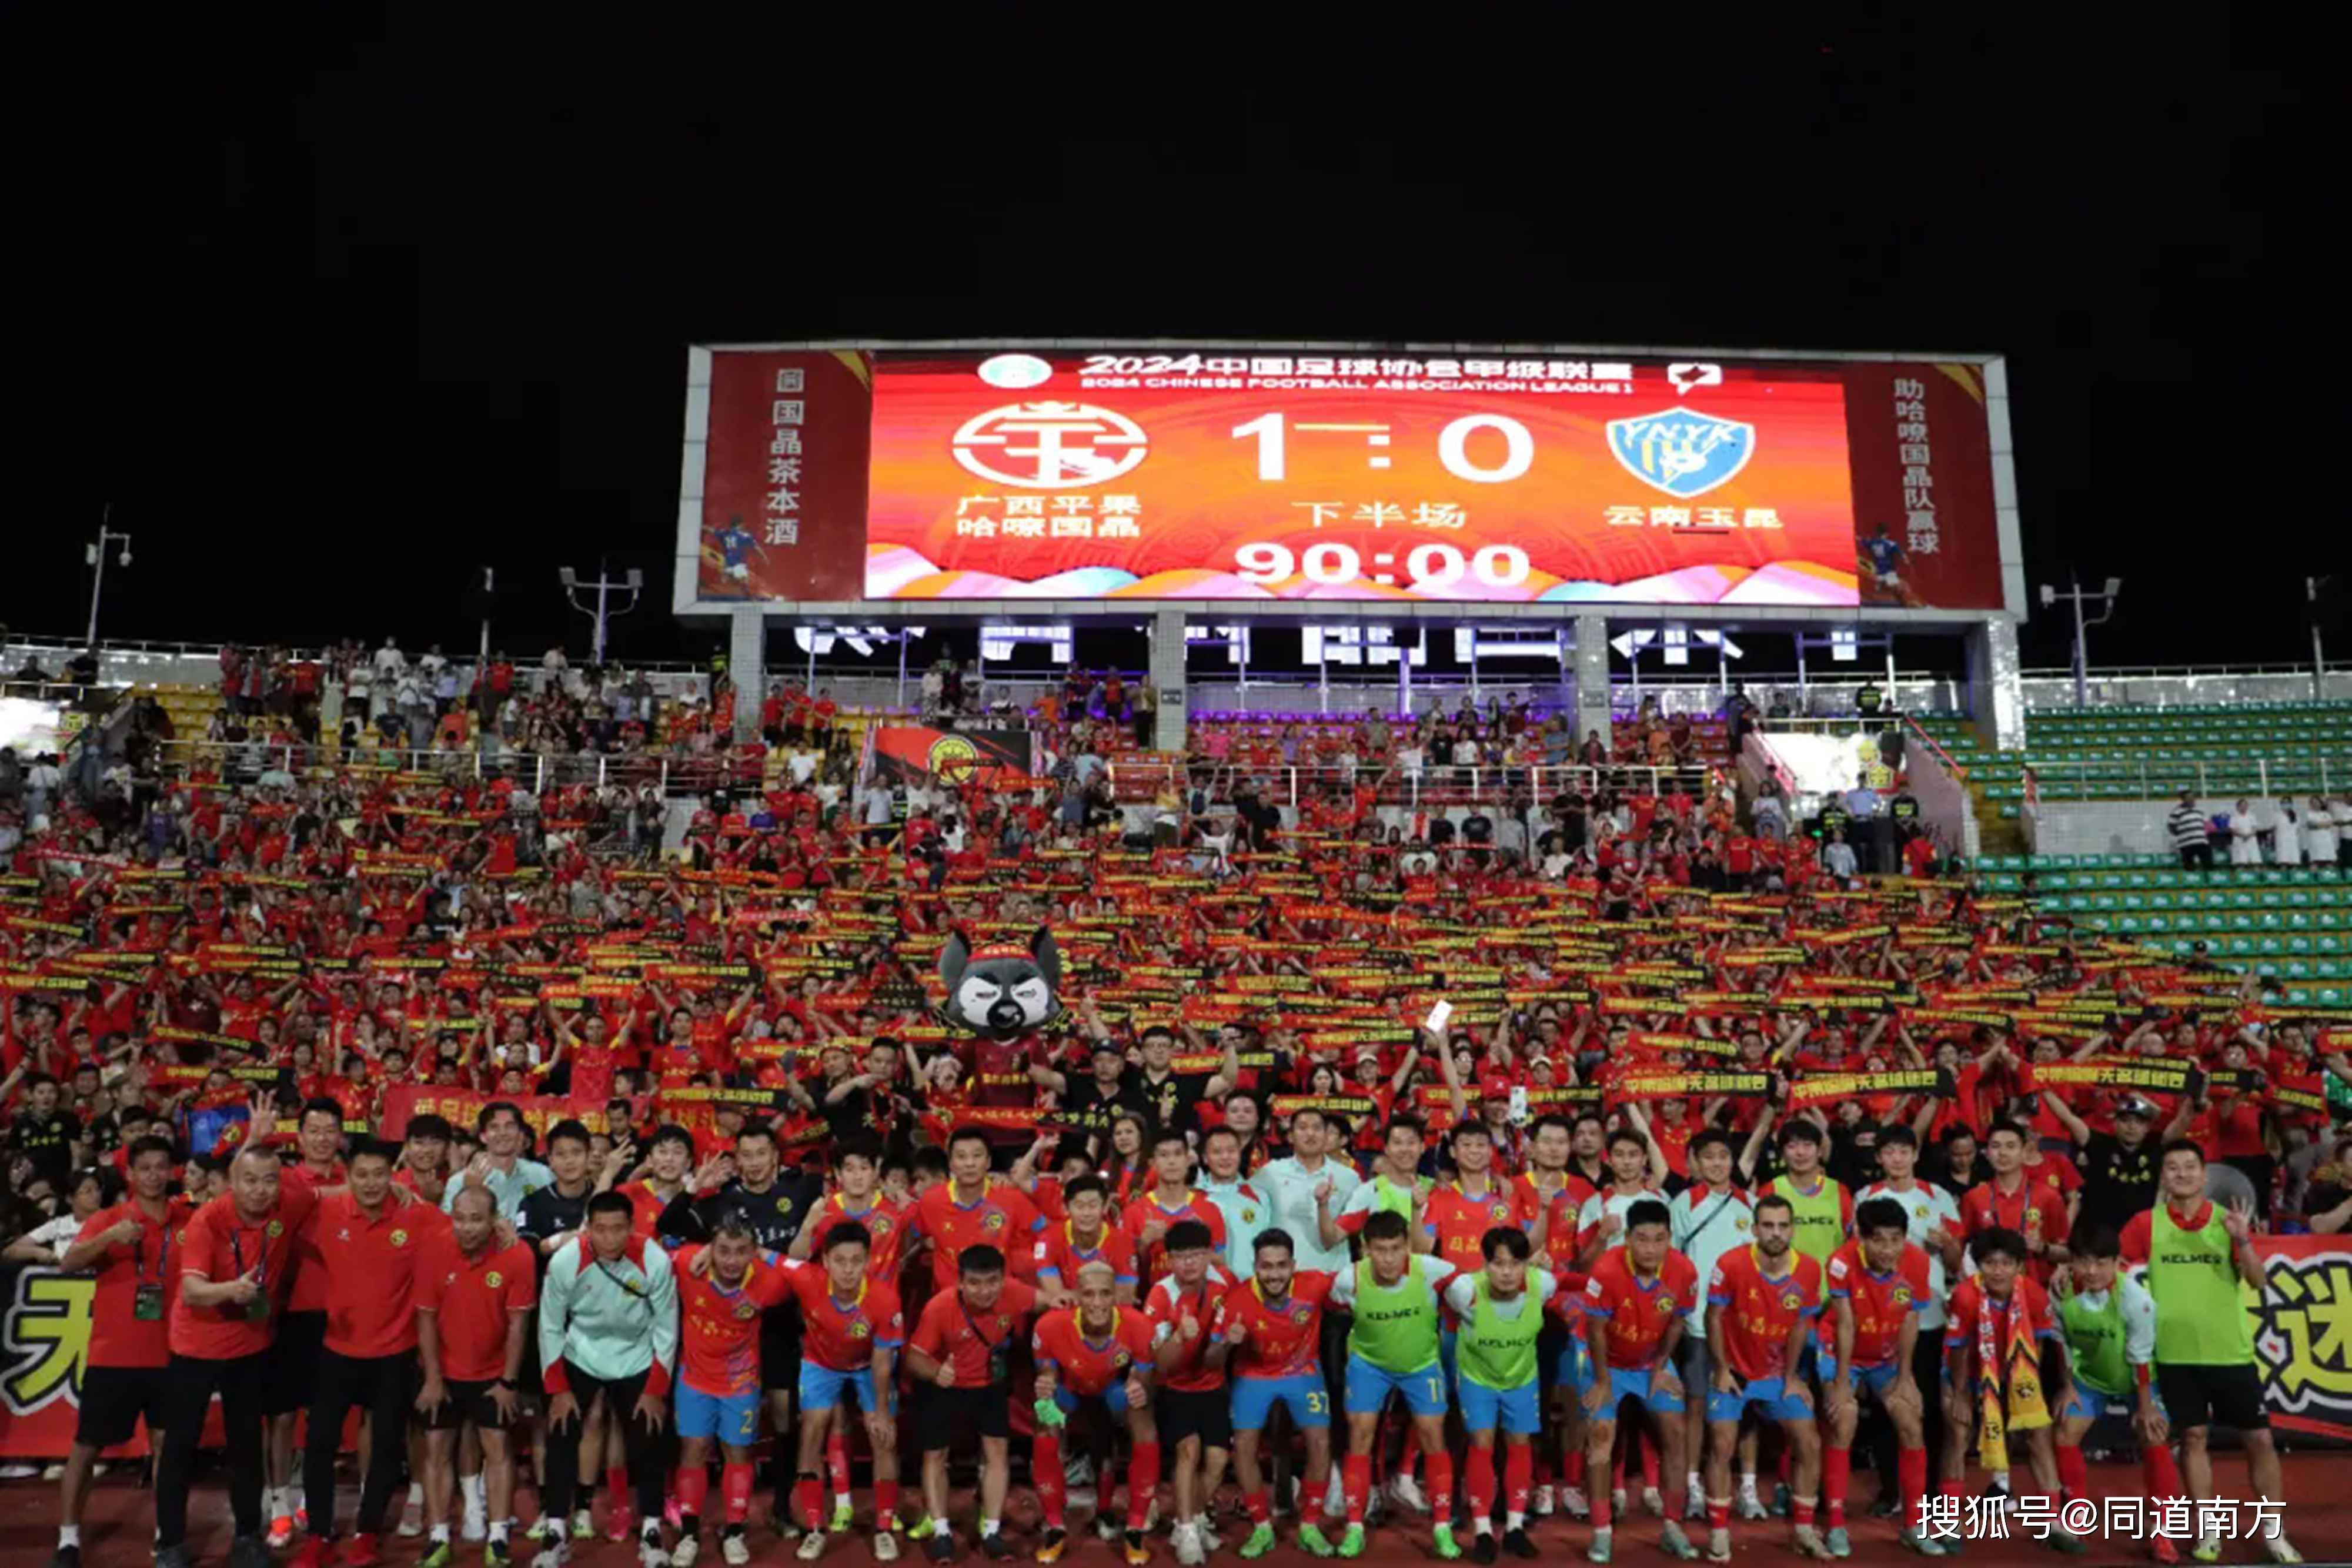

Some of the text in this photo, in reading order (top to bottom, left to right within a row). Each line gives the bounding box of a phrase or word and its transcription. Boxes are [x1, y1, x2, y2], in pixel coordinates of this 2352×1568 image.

[1082, 377, 1140, 388] 2024
[1145, 377, 1242, 389] CHINESE
[1248, 379, 1368, 389] FOOTBALL
[1373, 379, 1526, 393] ASSOCIATION
[1531, 382, 1621, 394] LEAGUE
[957, 496, 1141, 515] 广西平果
[1292, 502, 1468, 528] 下半场
[957, 516, 1140, 537] 哈嘹国晶
[1603, 506, 1783, 528] 云南玉昆
[1235, 543, 1530, 586] 90:00
